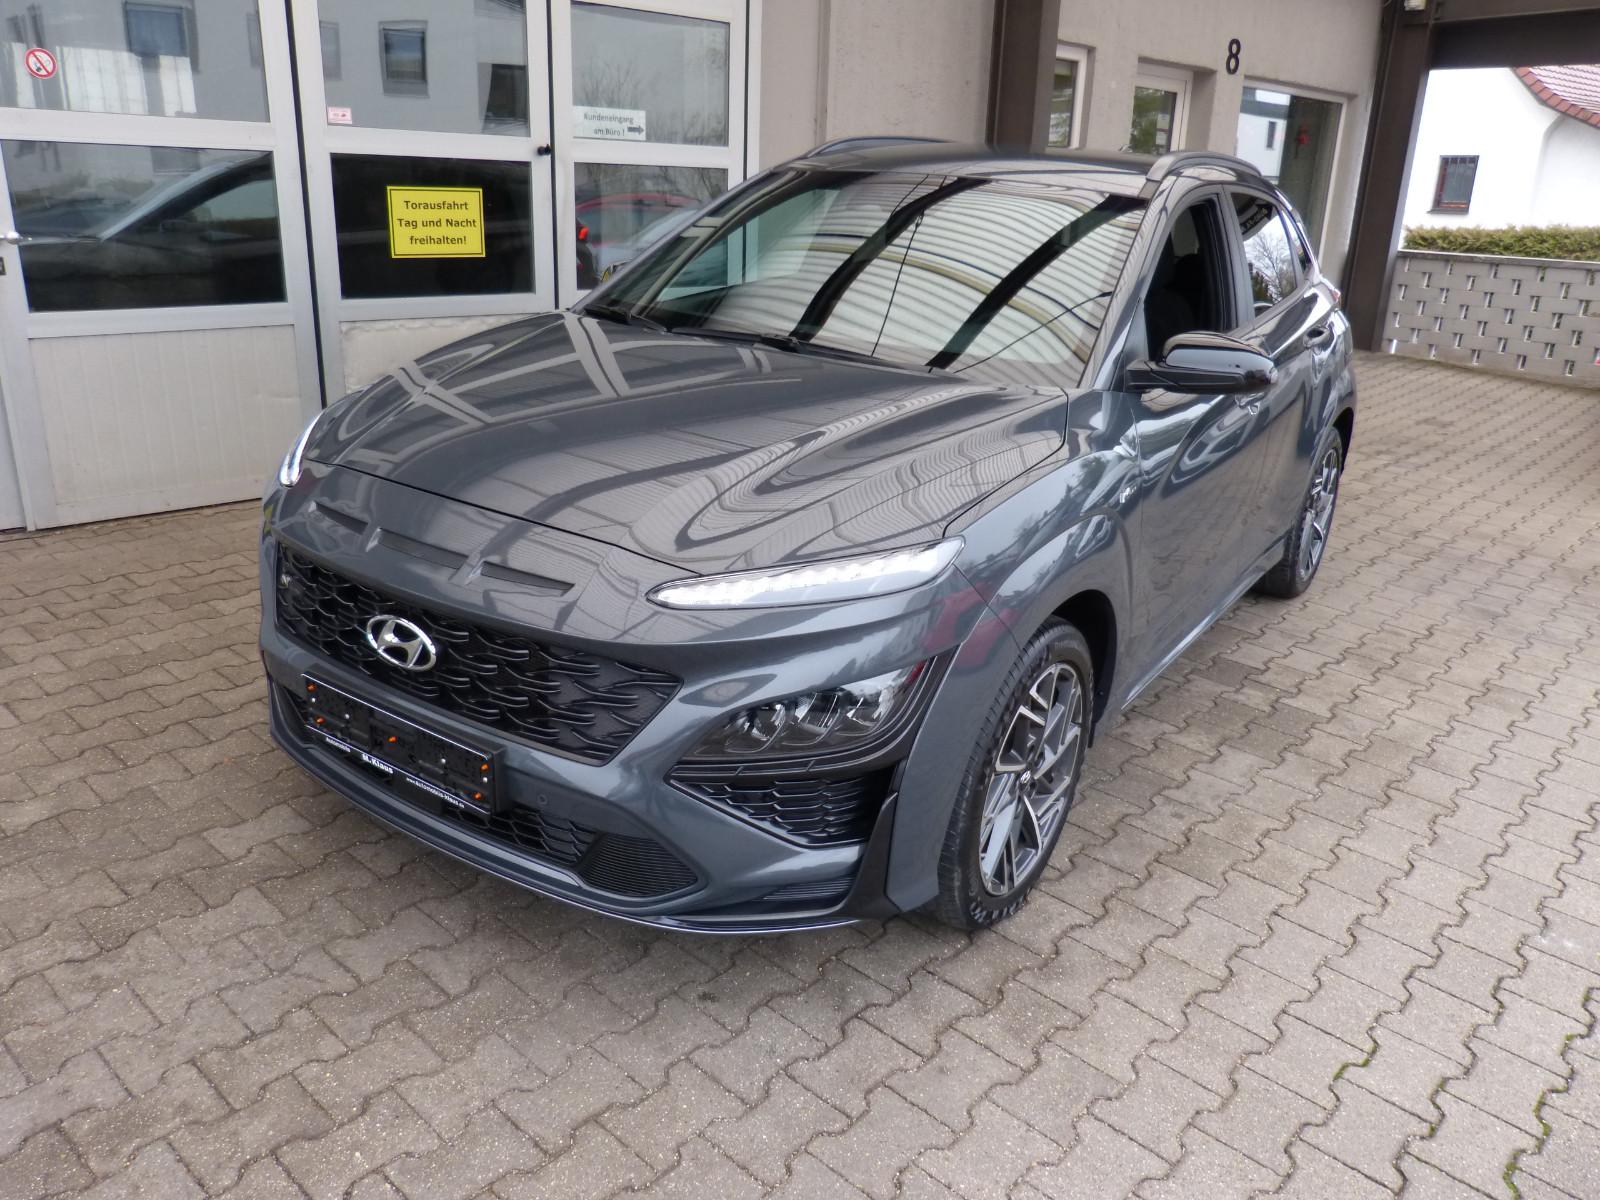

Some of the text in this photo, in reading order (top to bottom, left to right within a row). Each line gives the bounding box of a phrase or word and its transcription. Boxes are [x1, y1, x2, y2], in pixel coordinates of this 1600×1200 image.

[1226, 38, 1241, 75] 8
[594, 128, 604, 136] am
[403, 200, 469, 211] Torausfahrt
[397, 218, 477, 230] Tag und Nacht
[409, 235, 467, 245] freihalten!
